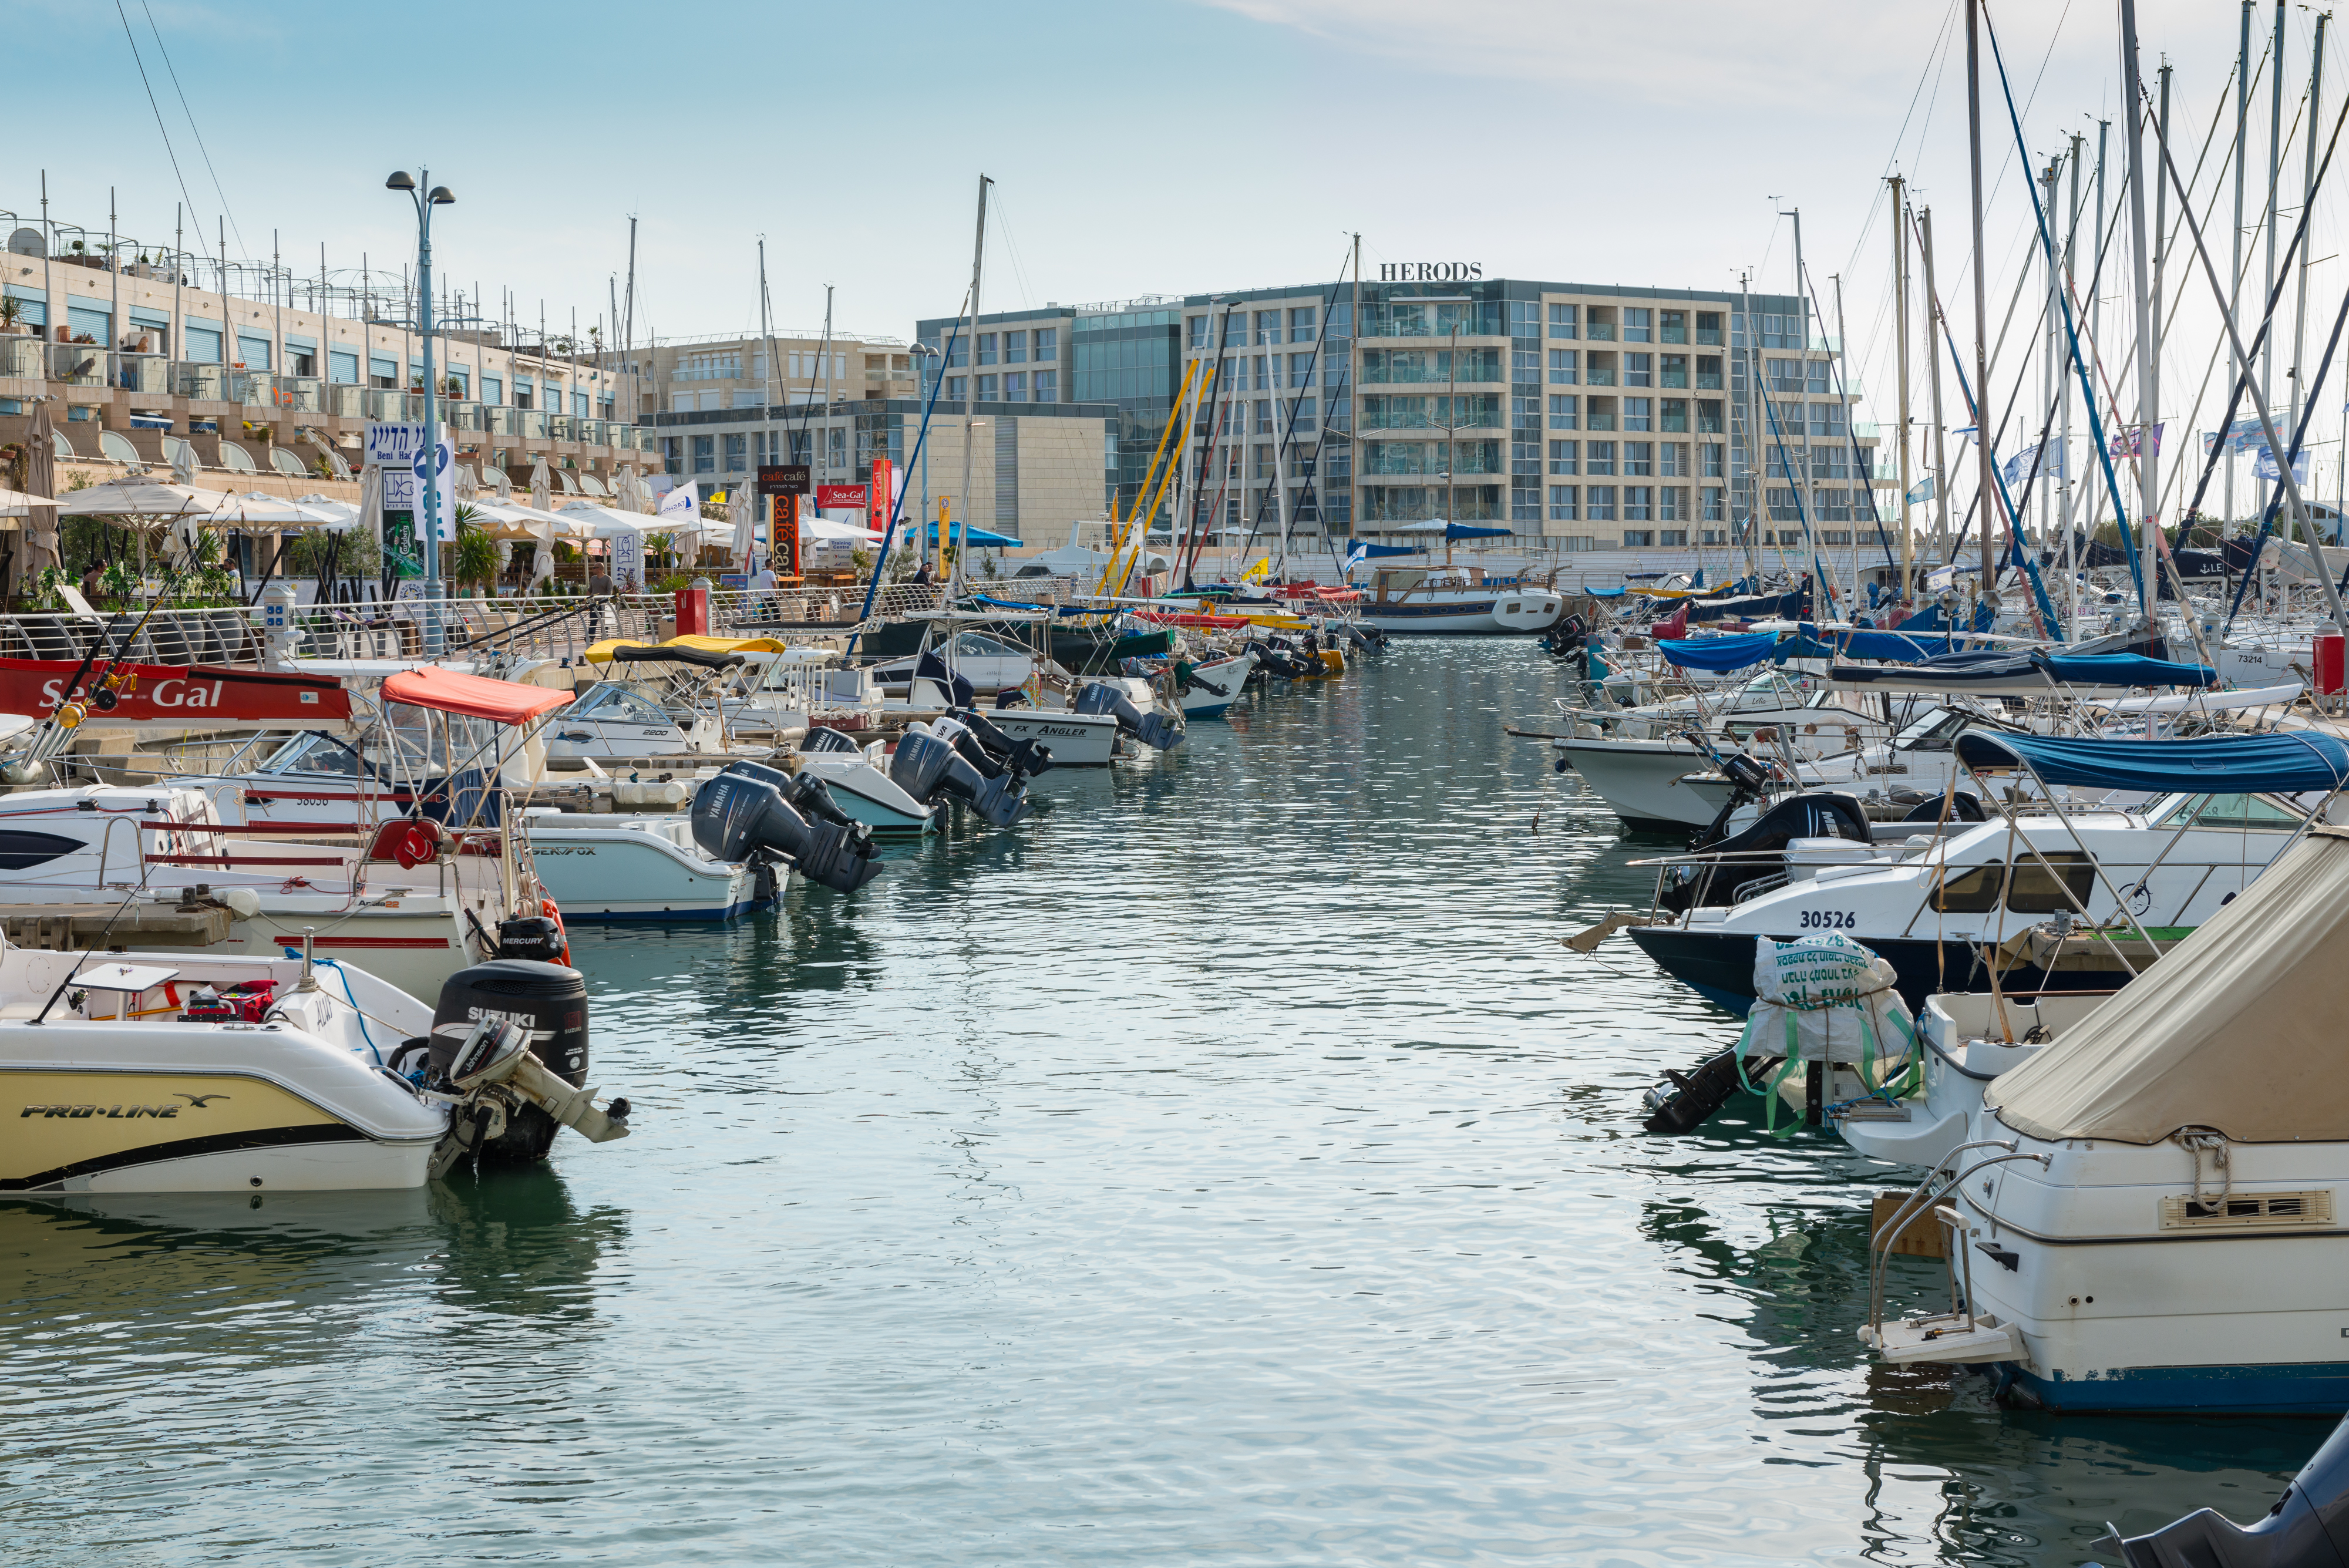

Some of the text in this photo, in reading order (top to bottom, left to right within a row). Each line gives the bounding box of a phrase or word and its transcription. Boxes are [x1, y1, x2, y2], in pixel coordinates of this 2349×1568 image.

[1380, 262, 1482, 281] HERODS
[370, 426, 408, 451] הדייג
[377, 451, 393, 459] Beni
[833, 490, 864, 499] Sea-Gal
[399, 525, 409, 555] Carlsberg
[2238, 655, 2262, 664] 73214
[1089, 685, 1100, 701] YAMAHA
[908, 737, 924, 761] YAMAHA
[805, 774, 813, 784] 9.9
[1734, 761, 1760, 780] MERCURY
[709, 784, 730, 818] YAMAHA
[1800, 911, 1856, 928] 30526
[1777, 953, 1805, 967] אספקת
[1807, 952, 1818, 964] כל
[1782, 970, 1807, 984] חברה
[468, 1007, 536, 1027] SUZUKI
[564, 1011, 582, 1029] 150
[466, 1039, 489, 1072] Johnson
